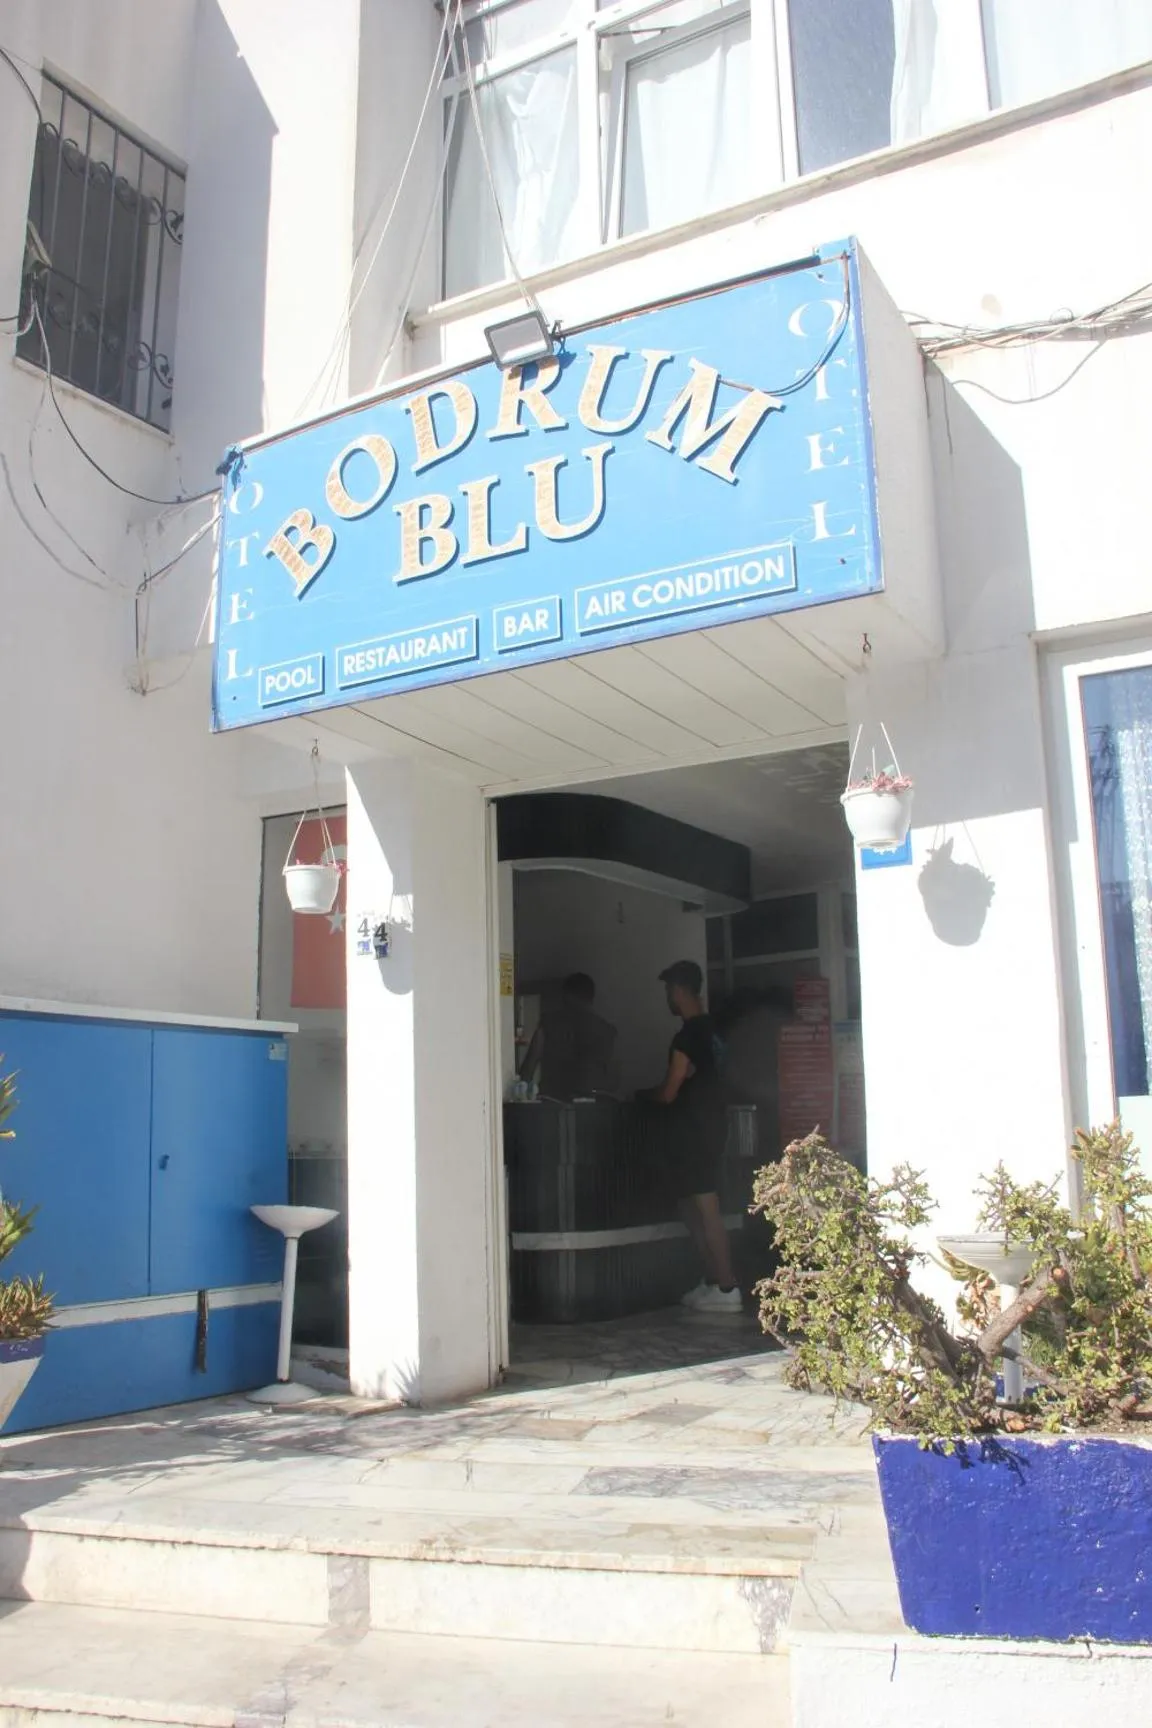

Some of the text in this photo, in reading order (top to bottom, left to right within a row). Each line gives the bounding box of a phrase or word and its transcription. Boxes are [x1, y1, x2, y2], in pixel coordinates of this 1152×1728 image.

[263, 344, 785, 597] BODRUM
[789, 300, 854, 540] OTEL
[393, 441, 614, 584] BLU
[226, 481, 264, 681] OTEL
[503, 608, 548, 639] BAR
[585, 556, 785, 620] AIR CONDITION
[264, 664, 316, 695] POOL
[343, 627, 468, 676] RESTAURANT
